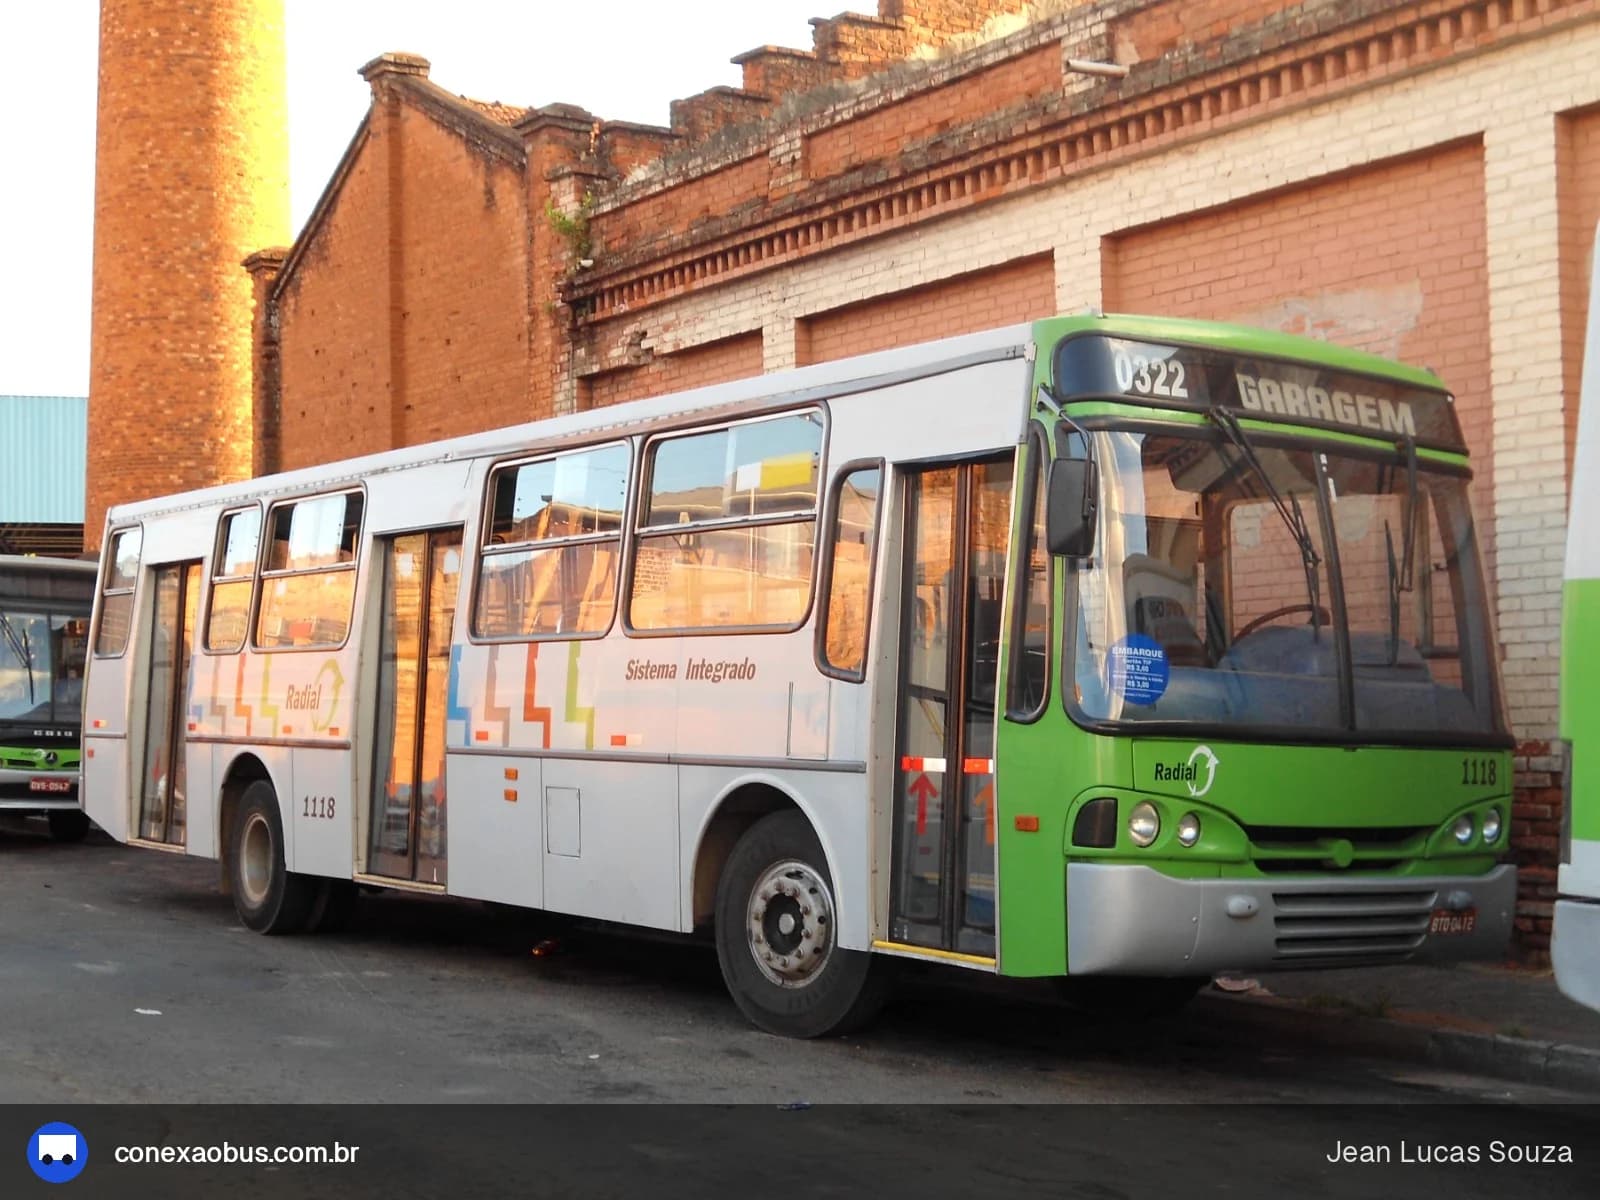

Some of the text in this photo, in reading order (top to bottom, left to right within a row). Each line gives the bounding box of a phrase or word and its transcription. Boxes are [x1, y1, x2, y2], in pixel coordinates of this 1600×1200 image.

[1114, 351, 1188, 398] 0322
[1236, 373, 1416, 437] GARAGEM
[1112, 647, 1163, 658] EMBARQUE
[625, 657, 756, 683] Sistema Integrado
[286, 684, 322, 710] Radial
[1154, 762, 1197, 781] Radial
[1462, 758, 1496, 785] 1118
[303, 795, 336, 819] 1118
